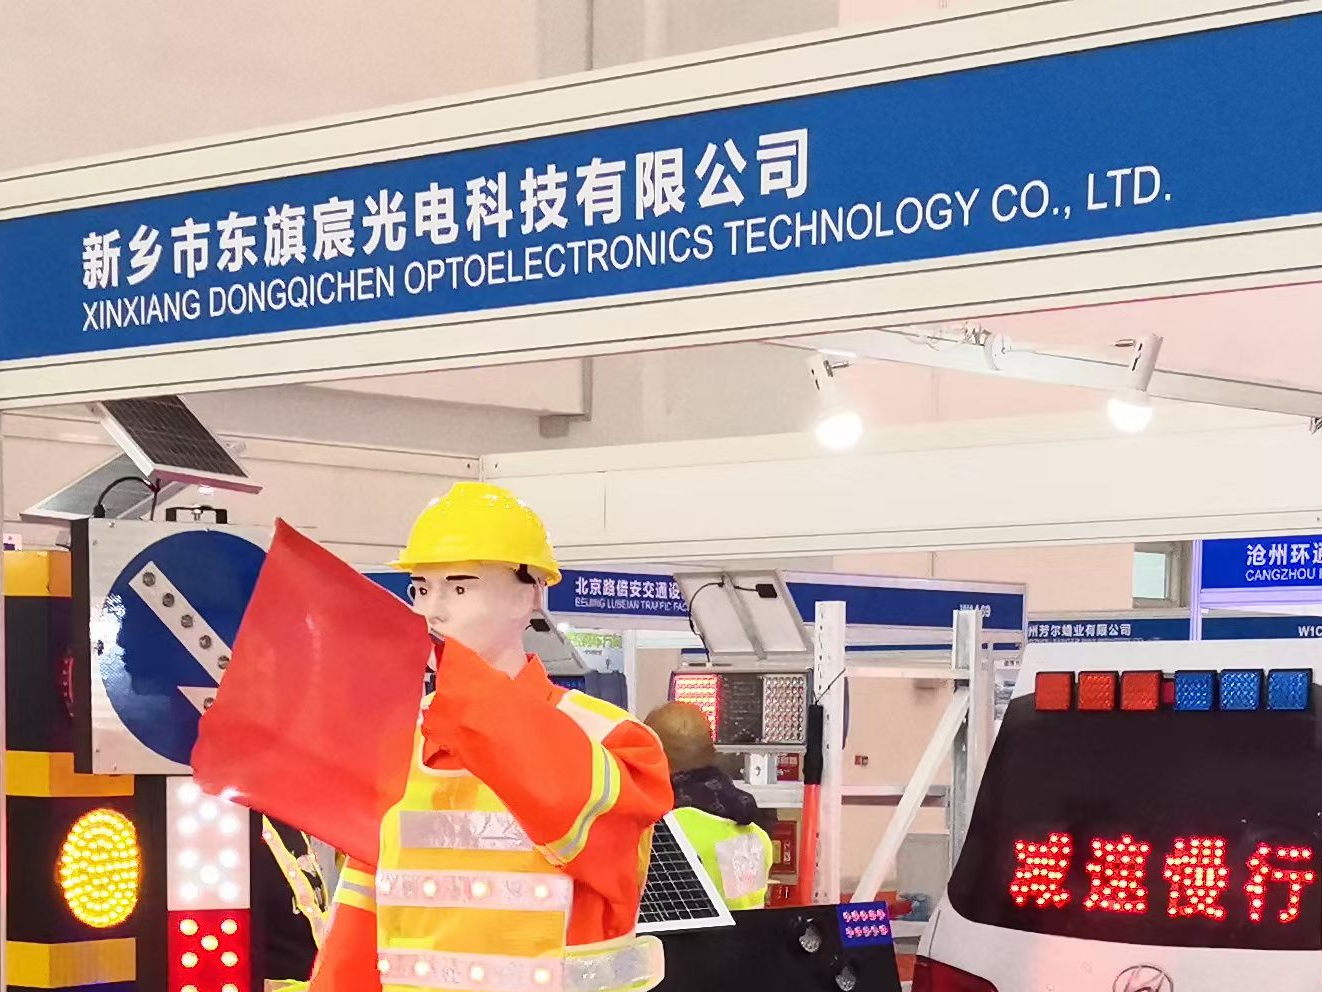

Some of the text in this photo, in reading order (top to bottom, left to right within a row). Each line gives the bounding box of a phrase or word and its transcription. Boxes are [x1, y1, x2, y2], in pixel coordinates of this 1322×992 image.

[82, 128, 809, 291] 新乡市东旗宸光电科技有限公司
[82, 164, 1173, 331] XINXIANG DONGQICHEN OPTOELECTRONICS TECHNOLOGY CO., LTD.
[575, 577, 684, 600] 北京路倍安交通设
[1245, 567, 1316, 582] CANGZHOU
